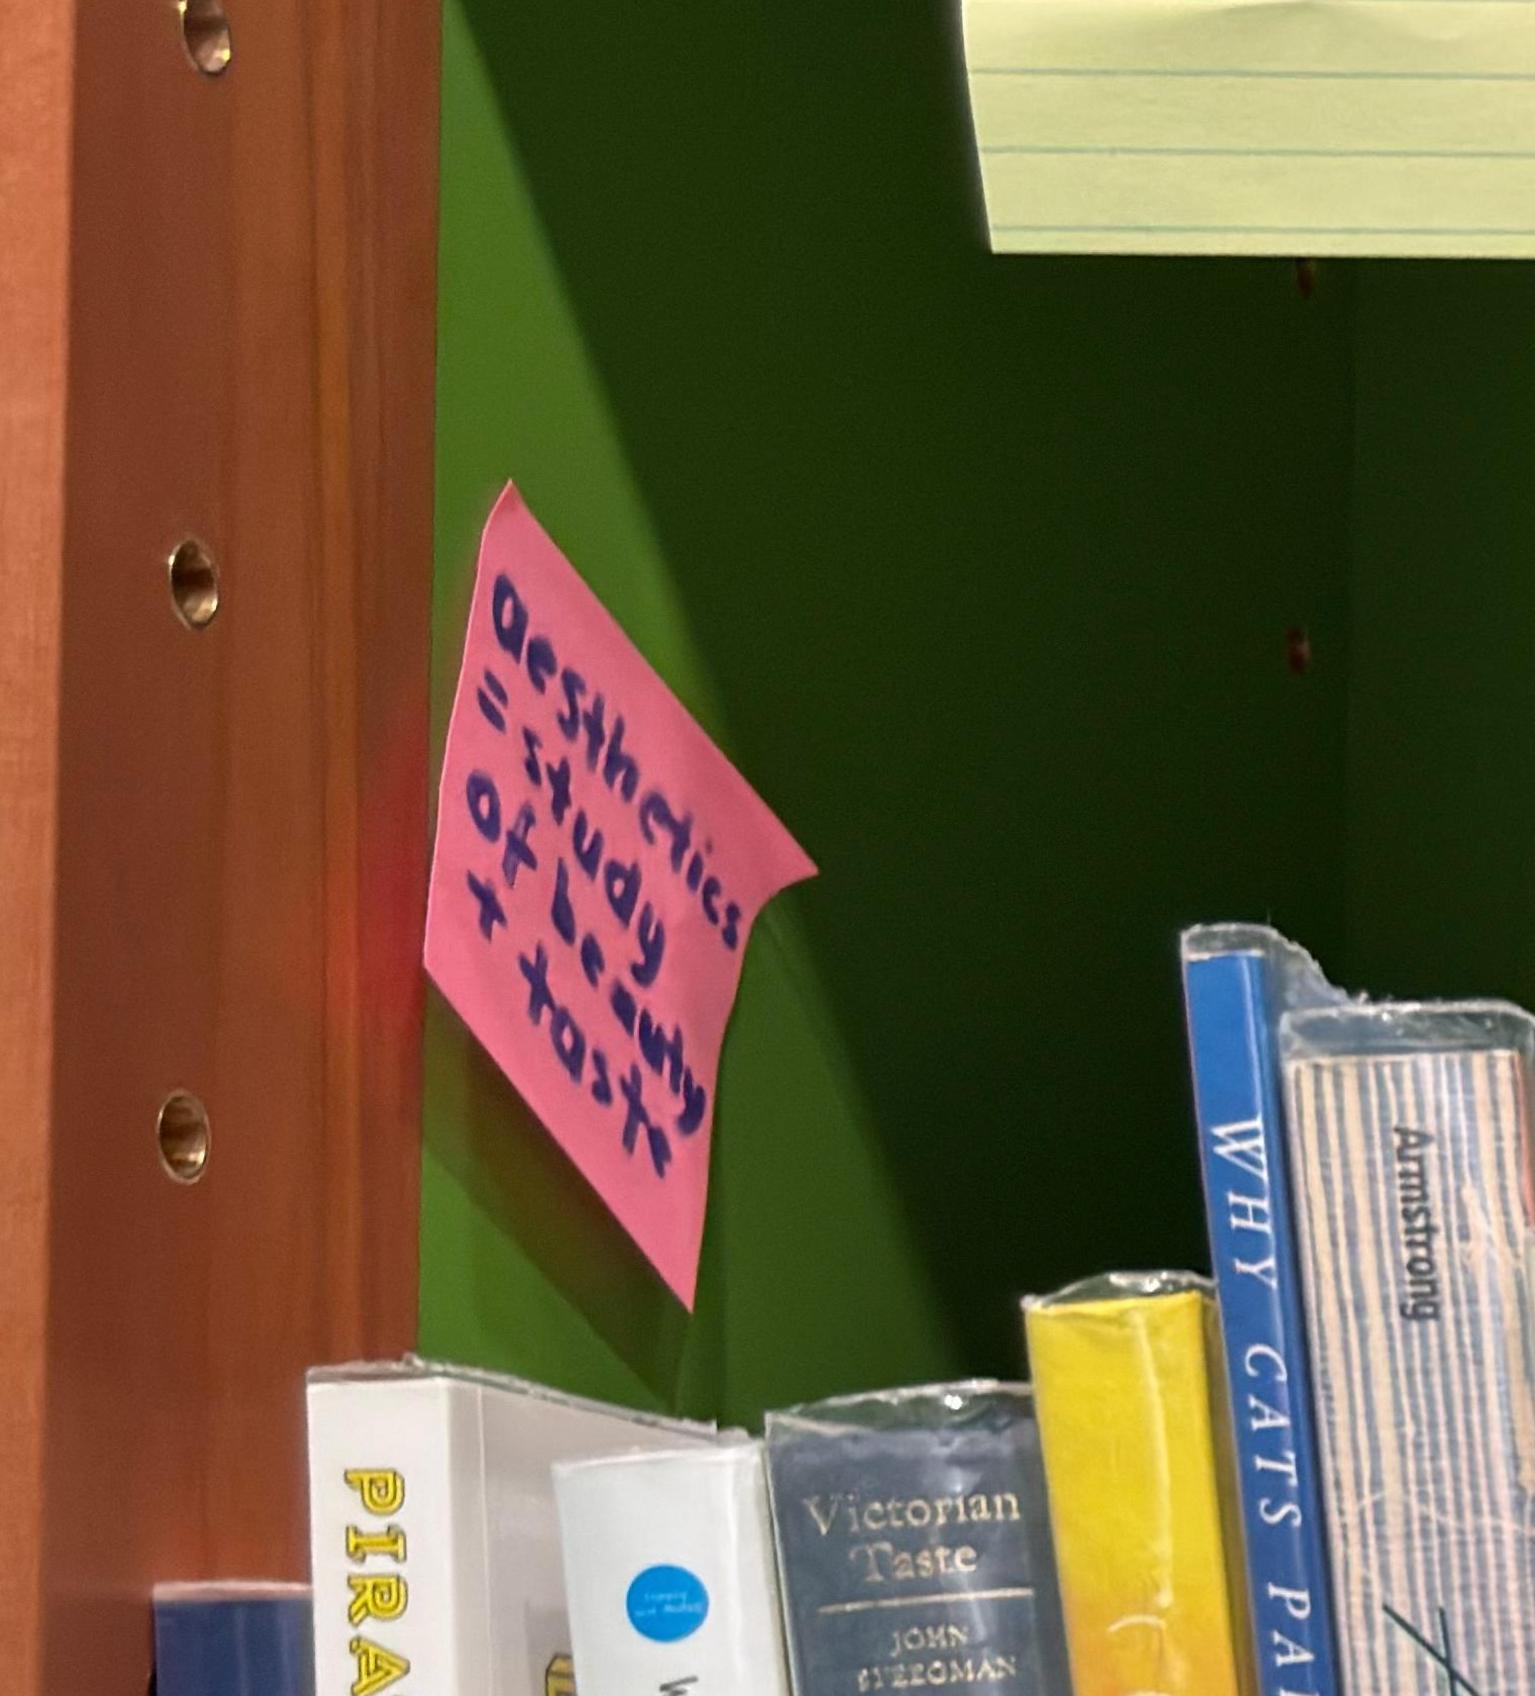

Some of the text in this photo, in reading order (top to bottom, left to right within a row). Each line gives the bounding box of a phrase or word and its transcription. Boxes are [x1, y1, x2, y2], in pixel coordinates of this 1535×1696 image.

[491, 574, 740, 952] aesthetics
[522, 723, 665, 987] study
[465, 770, 707, 1137] of beauty
[1212, 1116, 1280, 1294] WHY
[1392, 1125, 1442, 1323] Armstrong
[803, 1492, 1021, 1536] Victorian
[1244, 1344, 1303, 1530] CATS
[850, 1541, 977, 1582] Taste
